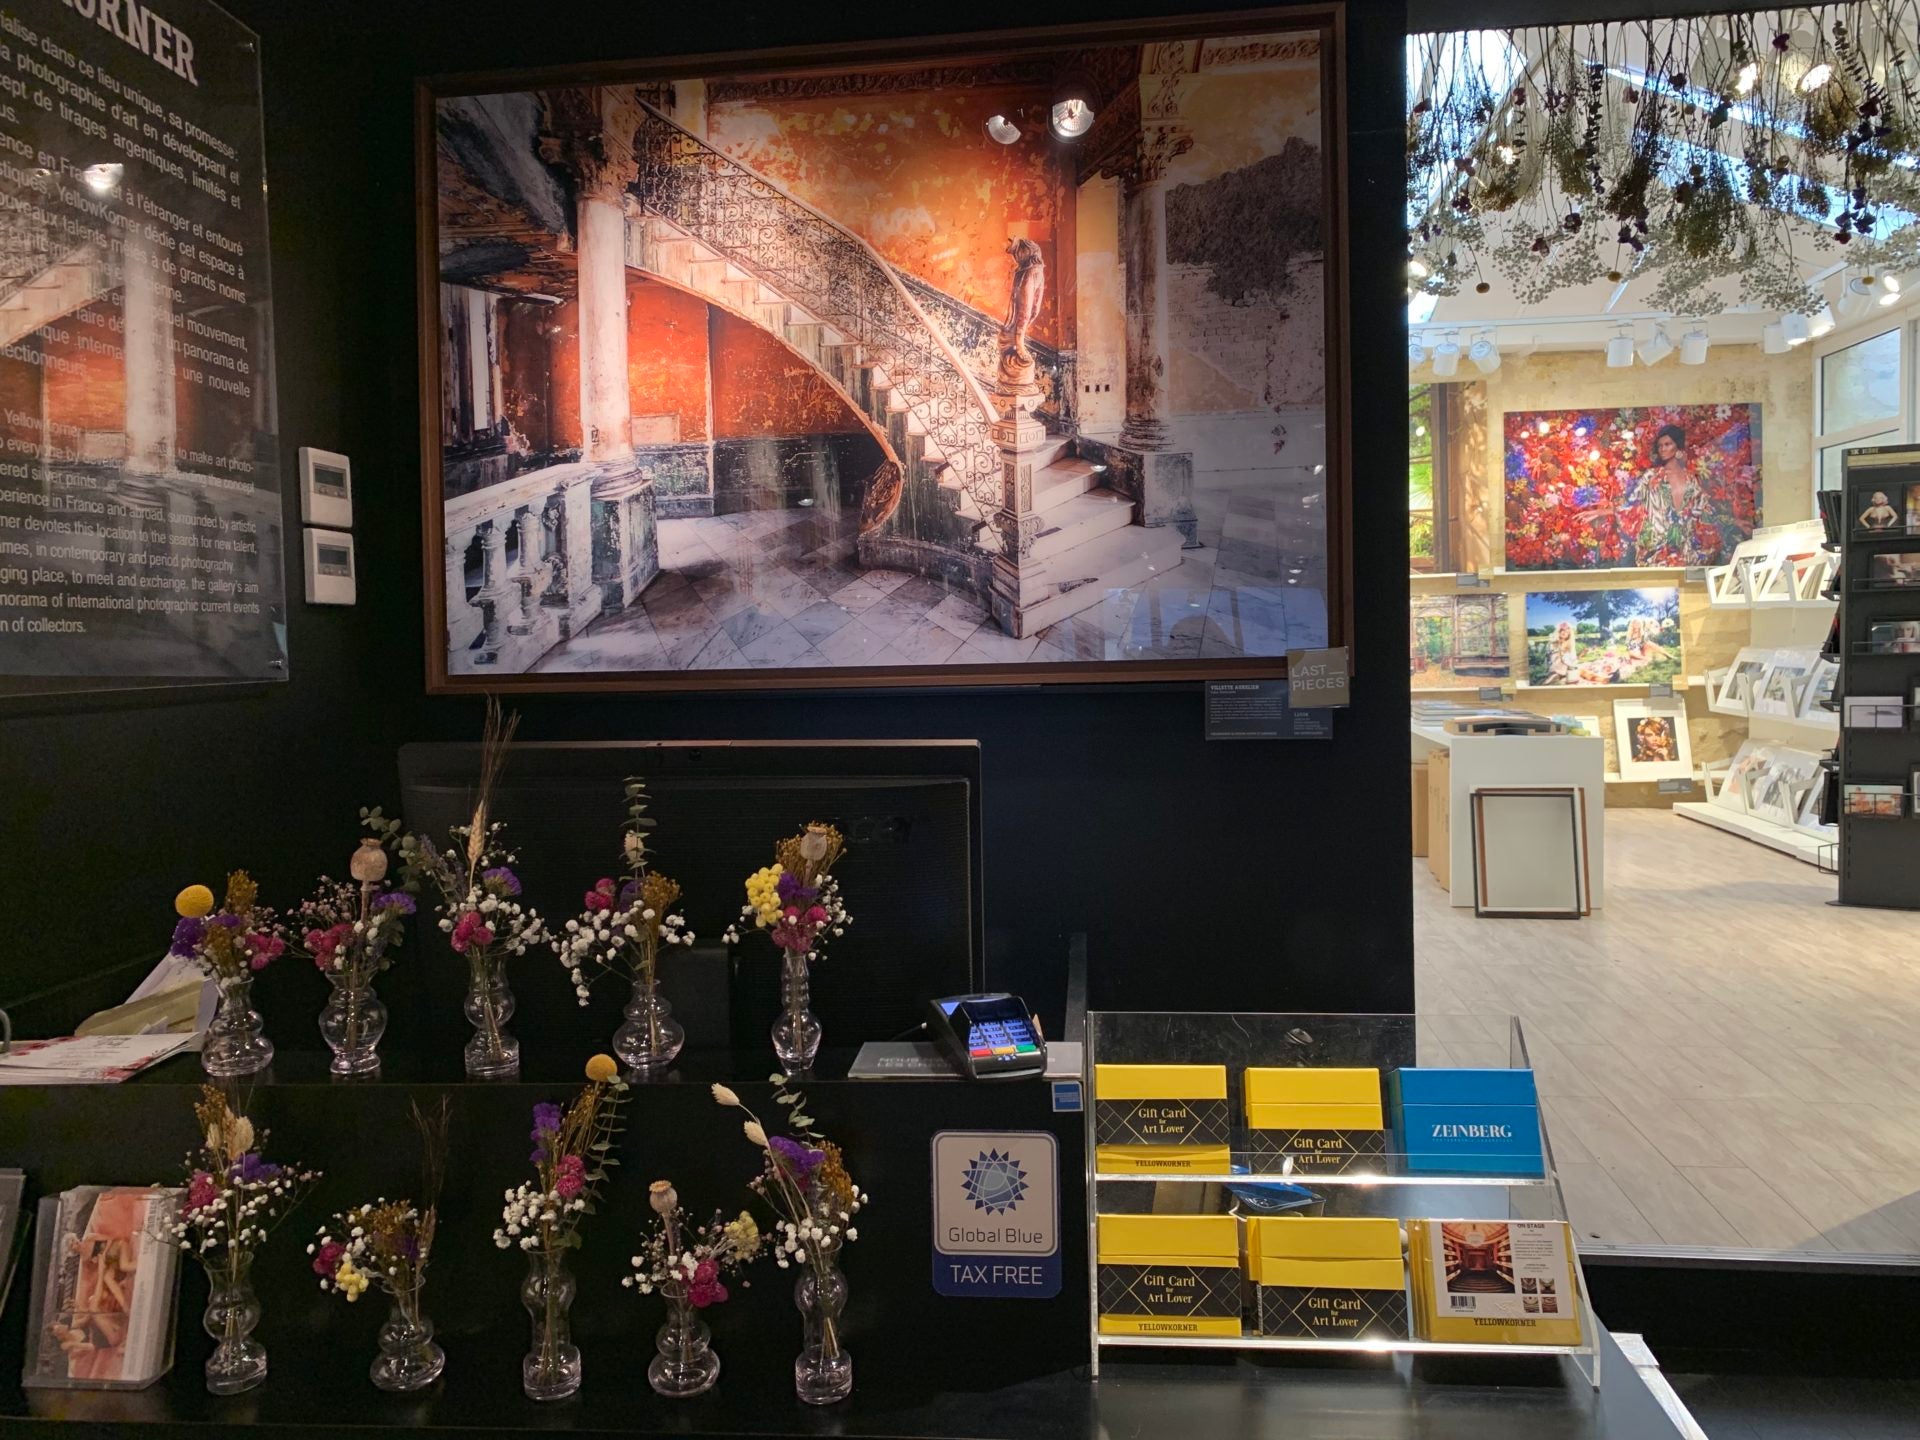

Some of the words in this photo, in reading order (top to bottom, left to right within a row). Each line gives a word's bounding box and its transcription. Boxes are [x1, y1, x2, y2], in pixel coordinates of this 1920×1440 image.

[41, 36, 76, 68] dans
[78, 60, 94, 79] ce
[97, 66, 120, 93] lieu
[123, 85, 167, 122] unique,
[168, 112, 183, 130] sa
[17, 53, 107, 112] photographie
[111, 103, 138, 131] d'art
[143, 123, 158, 140] en
[162, 131, 226, 178] développant
[229, 171, 240, 186] et
[0, 74, 27, 99] ept
[33, 88, 53, 112] de
[60, 101, 107, 140] tirages
[113, 132, 187, 184] argentiques,
[192, 170, 227, 202] limités
[230, 194, 241, 210] et
[37, 150, 56, 170] en
[126, 188, 135, 206] à
[137, 193, 190, 231] l'étranger
[193, 223, 204, 239] et
[206, 229, 244, 256] entouré
[56, 182, 141, 233] YellowKorner
[144, 224, 176, 250] dédie
[179, 241, 196, 259] cet
[199, 250, 236, 276] espace
[238, 265, 245, 280] à
[62, 215, 108, 248] talents
[151, 252, 159, 269] à
[162, 258, 177, 275] de
[180, 267, 217, 292] grands
[219, 283, 246, 304] noms
[187, 318, 248, 353] mouvement,
[183, 343, 234, 370] panorama
[237, 359, 249, 374] de
[182, 367, 203, 384] une
[208, 375, 250, 398] nouvelle
[189, 451, 213, 465] make
[215, 457, 227, 468] art
[228, 457, 254, 472] photo-
[52, 493, 63, 508] in
[66, 495, 104, 514] France
[107, 503, 126, 516] and
[168, 512, 218, 528] surrounded
[220, 515, 229, 533] by
[25, 515, 71, 533] devotes
[75, 520, 94, 536] this
[97, 523, 137, 540] location
[139, 530, 149, 542] to
[151, 530, 166, 544] the
[169, 534, 199, 547] search
[201, 535, 212, 548] for
[215, 540, 231, 550] new
[36, 541, 47, 557] in
[50, 546, 125, 566] contemporary
[128, 551, 147, 564] and
[149, 553, 179, 568] period
[32, 567, 68, 586] place,
[72, 570, 82, 584] to
[86, 573, 114, 586] meet
[117, 573, 137, 587] and
[192, 577, 206, 590] the
[244, 582, 259, 593] aim
[51, 593, 63, 607] of
[67, 593, 135, 609] international
[137, 597, 199, 614] photographic
[201, 600, 231, 613] current
[233, 602, 260, 614] events
[12, 617, 24, 632] of
[27, 617, 87, 632] collectors.
[1291, 664, 1327, 678] LAST
[1292, 677, 1345, 691] PIECES
[1138, 1108, 1158, 1118] Gift
[1161, 1108, 1187, 1118] Card
[1142, 1125, 1158, 1134] Art
[1160, 1125, 1185, 1134] Lover
[1431, 1124, 1513, 1138] ZEINBERG
[1293, 1138, 1314, 1149] Gift
[1317, 1138, 1343, 1149] Card
[1135, 1160, 1191, 1168] YELLOWKORNER
[1298, 1155, 1314, 1164] Art
[1316, 1155, 1342, 1164] Lover
[948, 1227, 1001, 1243] Global
[1005, 1228, 1043, 1244] Blue
[949, 1264, 988, 1284] TAX
[992, 1265, 1043, 1285] FREE
[1144, 1274, 1166, 1287] Gift
[1168, 1275, 1195, 1287] Card
[1147, 1293, 1164, 1303] Art
[1167, 1293, 1193, 1304] Lover
[1308, 1297, 1330, 1309] Gift
[1333, 1298, 1361, 1310] Card
[1138, 1323, 1198, 1332] YELLOWKORNER
[1312, 1316, 1329, 1326] Art
[1332, 1316, 1359, 1327] Lover
[1473, 1317, 1537, 1327] YELLOWKORNER
